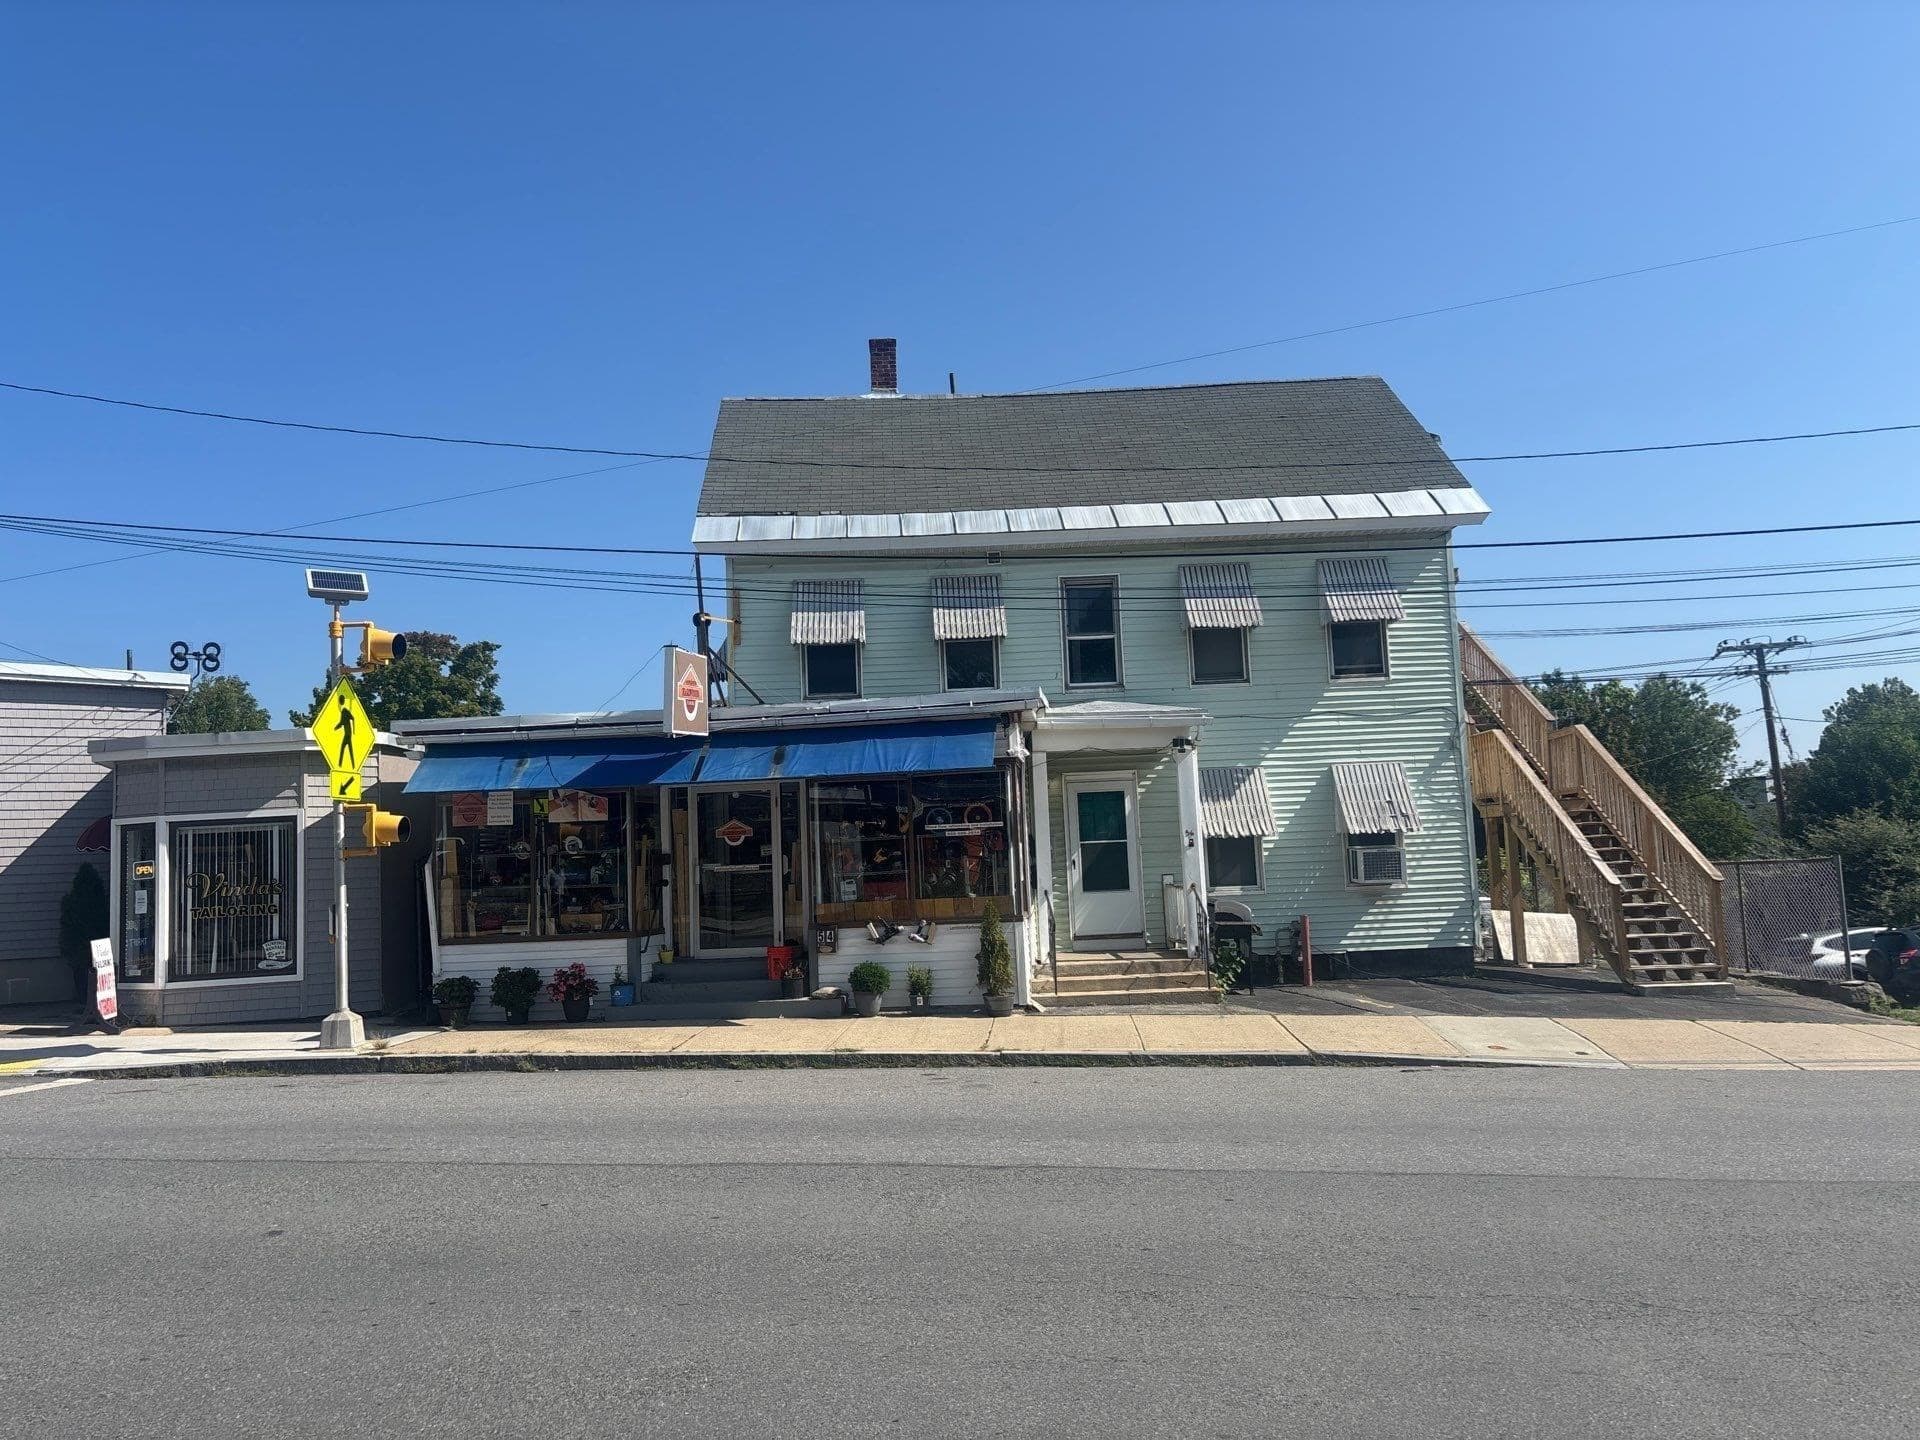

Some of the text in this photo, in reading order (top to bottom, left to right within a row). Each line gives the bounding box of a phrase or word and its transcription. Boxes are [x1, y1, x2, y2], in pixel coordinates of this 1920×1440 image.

[136, 865, 153, 876] OPEN
[186, 872, 283, 899] Vinda's
[190, 904, 279, 920] TAILORING
[818, 930, 834, 943] 54
